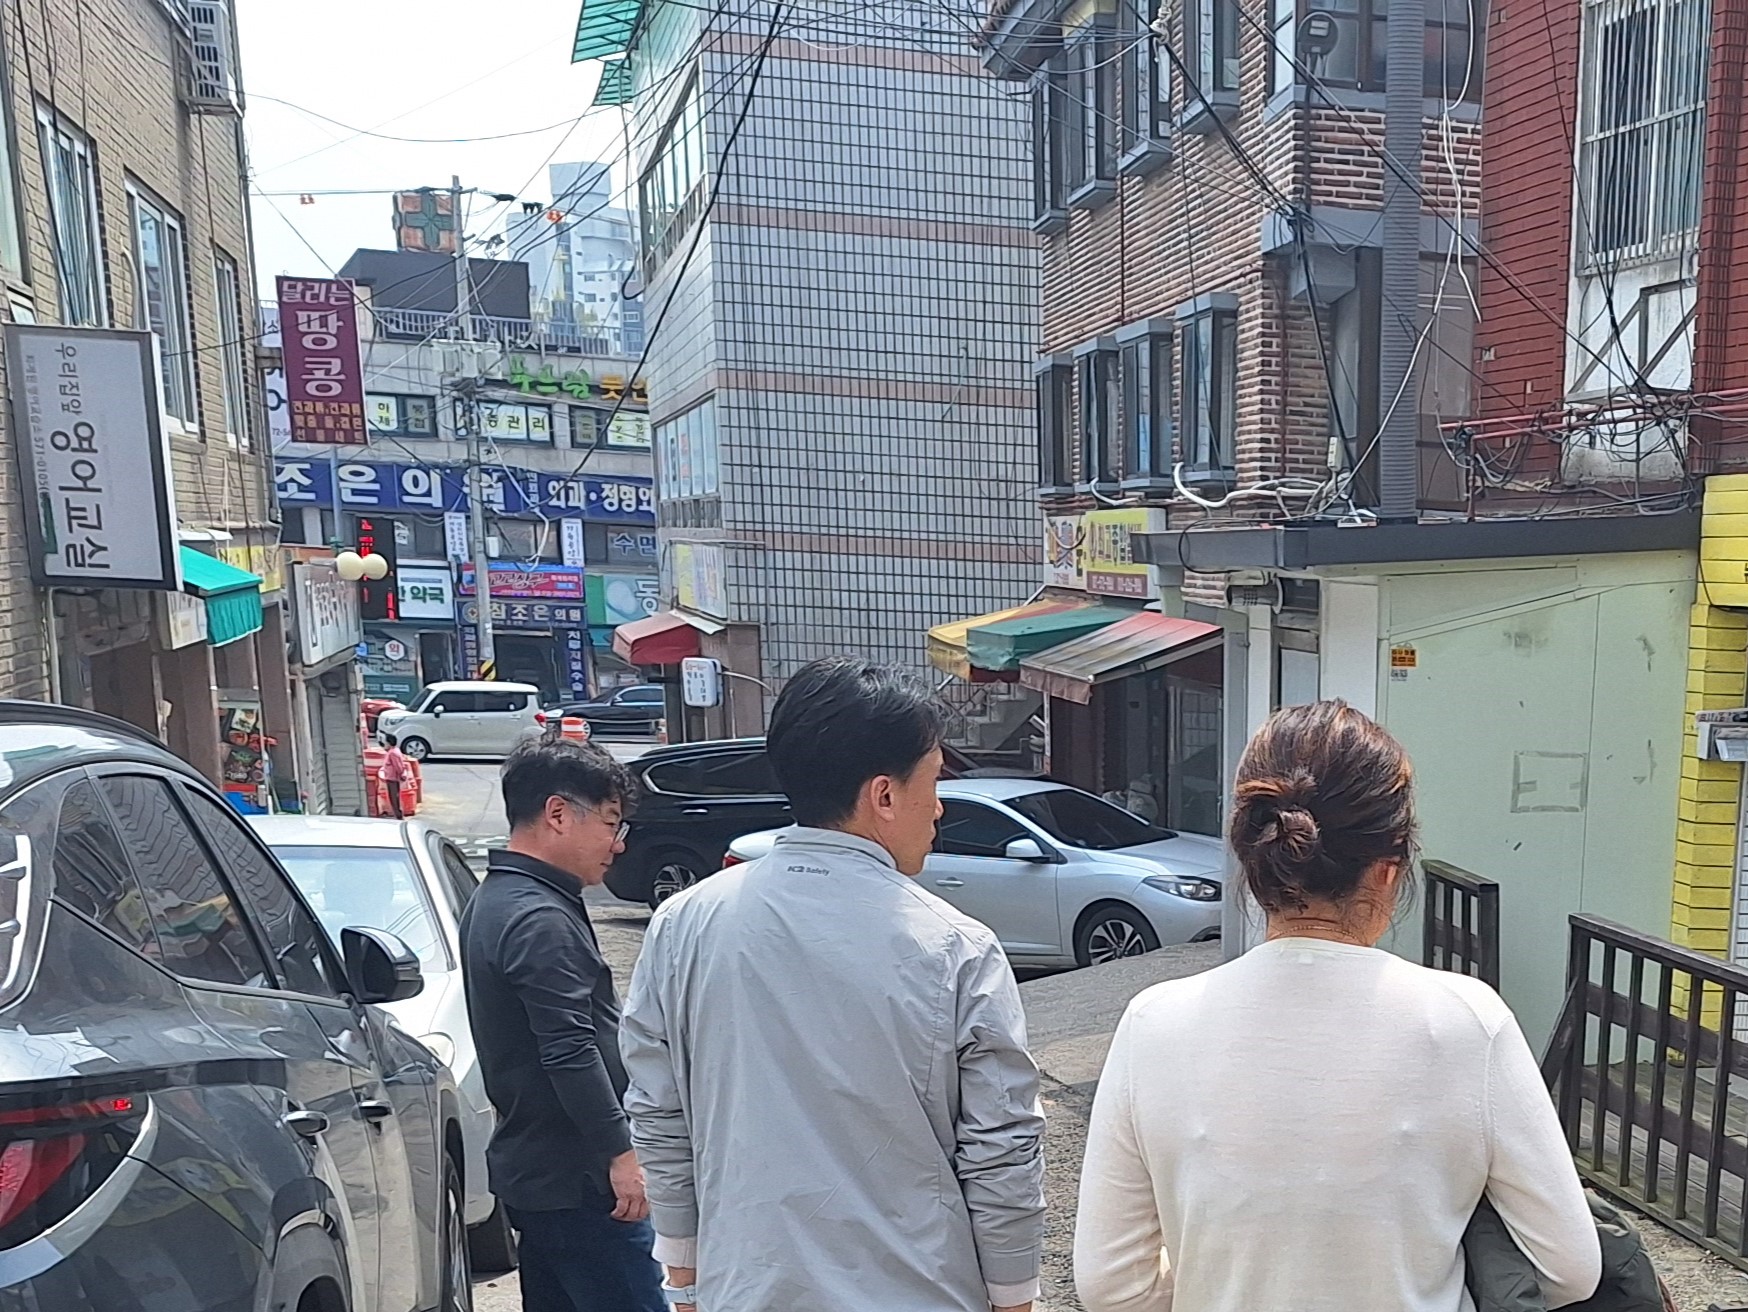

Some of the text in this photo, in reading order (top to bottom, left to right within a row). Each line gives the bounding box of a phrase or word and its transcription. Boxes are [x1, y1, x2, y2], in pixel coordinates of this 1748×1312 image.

[282, 280, 350, 305] 달리는
[55, 342, 81, 415] 우리집앞
[296, 309, 346, 397] 땅콩
[50, 421, 111, 569] 영어교실
[806, 866, 830, 877] Safety
